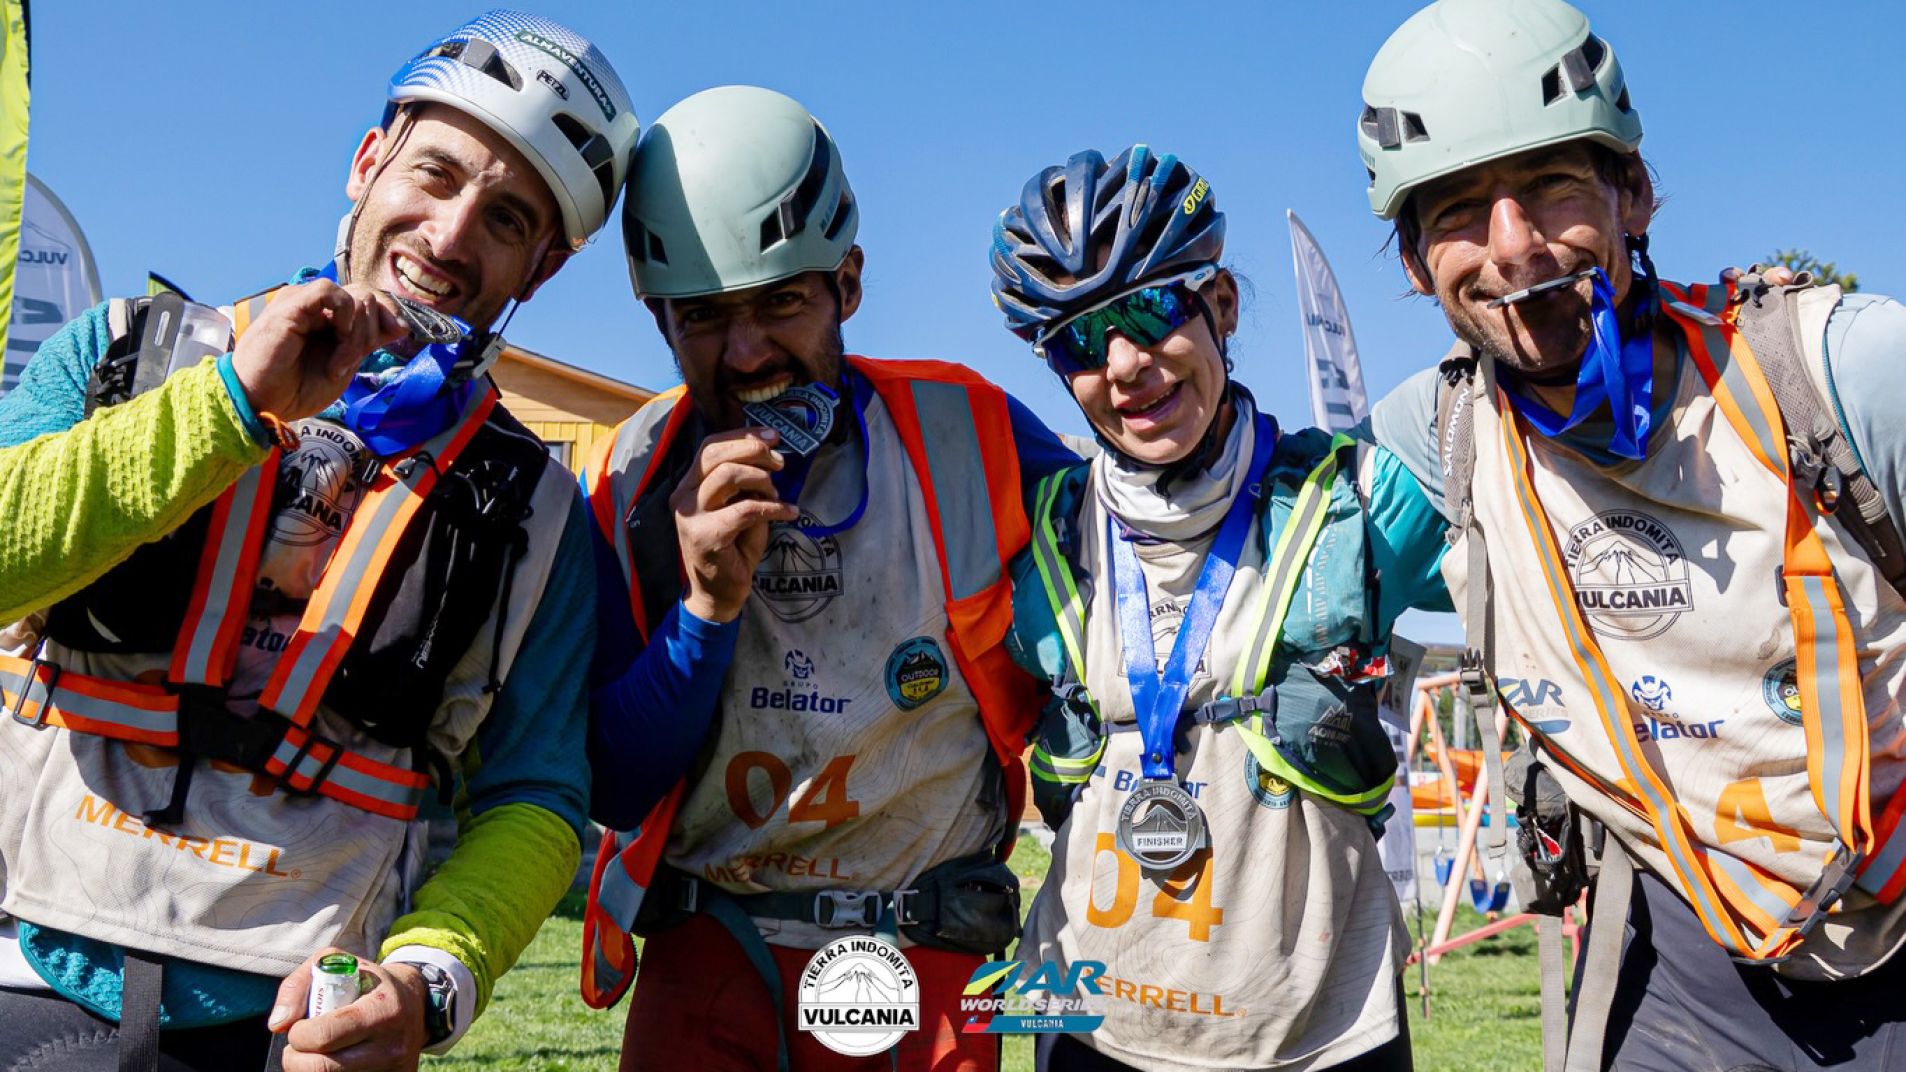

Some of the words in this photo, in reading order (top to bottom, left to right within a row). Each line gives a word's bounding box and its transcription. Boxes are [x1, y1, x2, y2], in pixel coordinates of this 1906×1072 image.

[521, 34, 613, 114] ALMAVENTURAS
[536, 70, 567, 100] PETZL
[1443, 388, 1470, 477] SALOMON
[1606, 516, 1680, 565] INDOMITA
[751, 687, 852, 714] Belator
[1633, 720, 1725, 742] elator
[725, 751, 859, 831] 04
[1122, 789, 1151, 821] TIERRA
[1152, 787, 1196, 820] INDOMITA
[76, 796, 287, 877] MERRELL
[1137, 837, 1183, 847] FINISHER
[704, 852, 849, 884] MERRELL
[1092, 974, 1235, 1017] ERRELL
